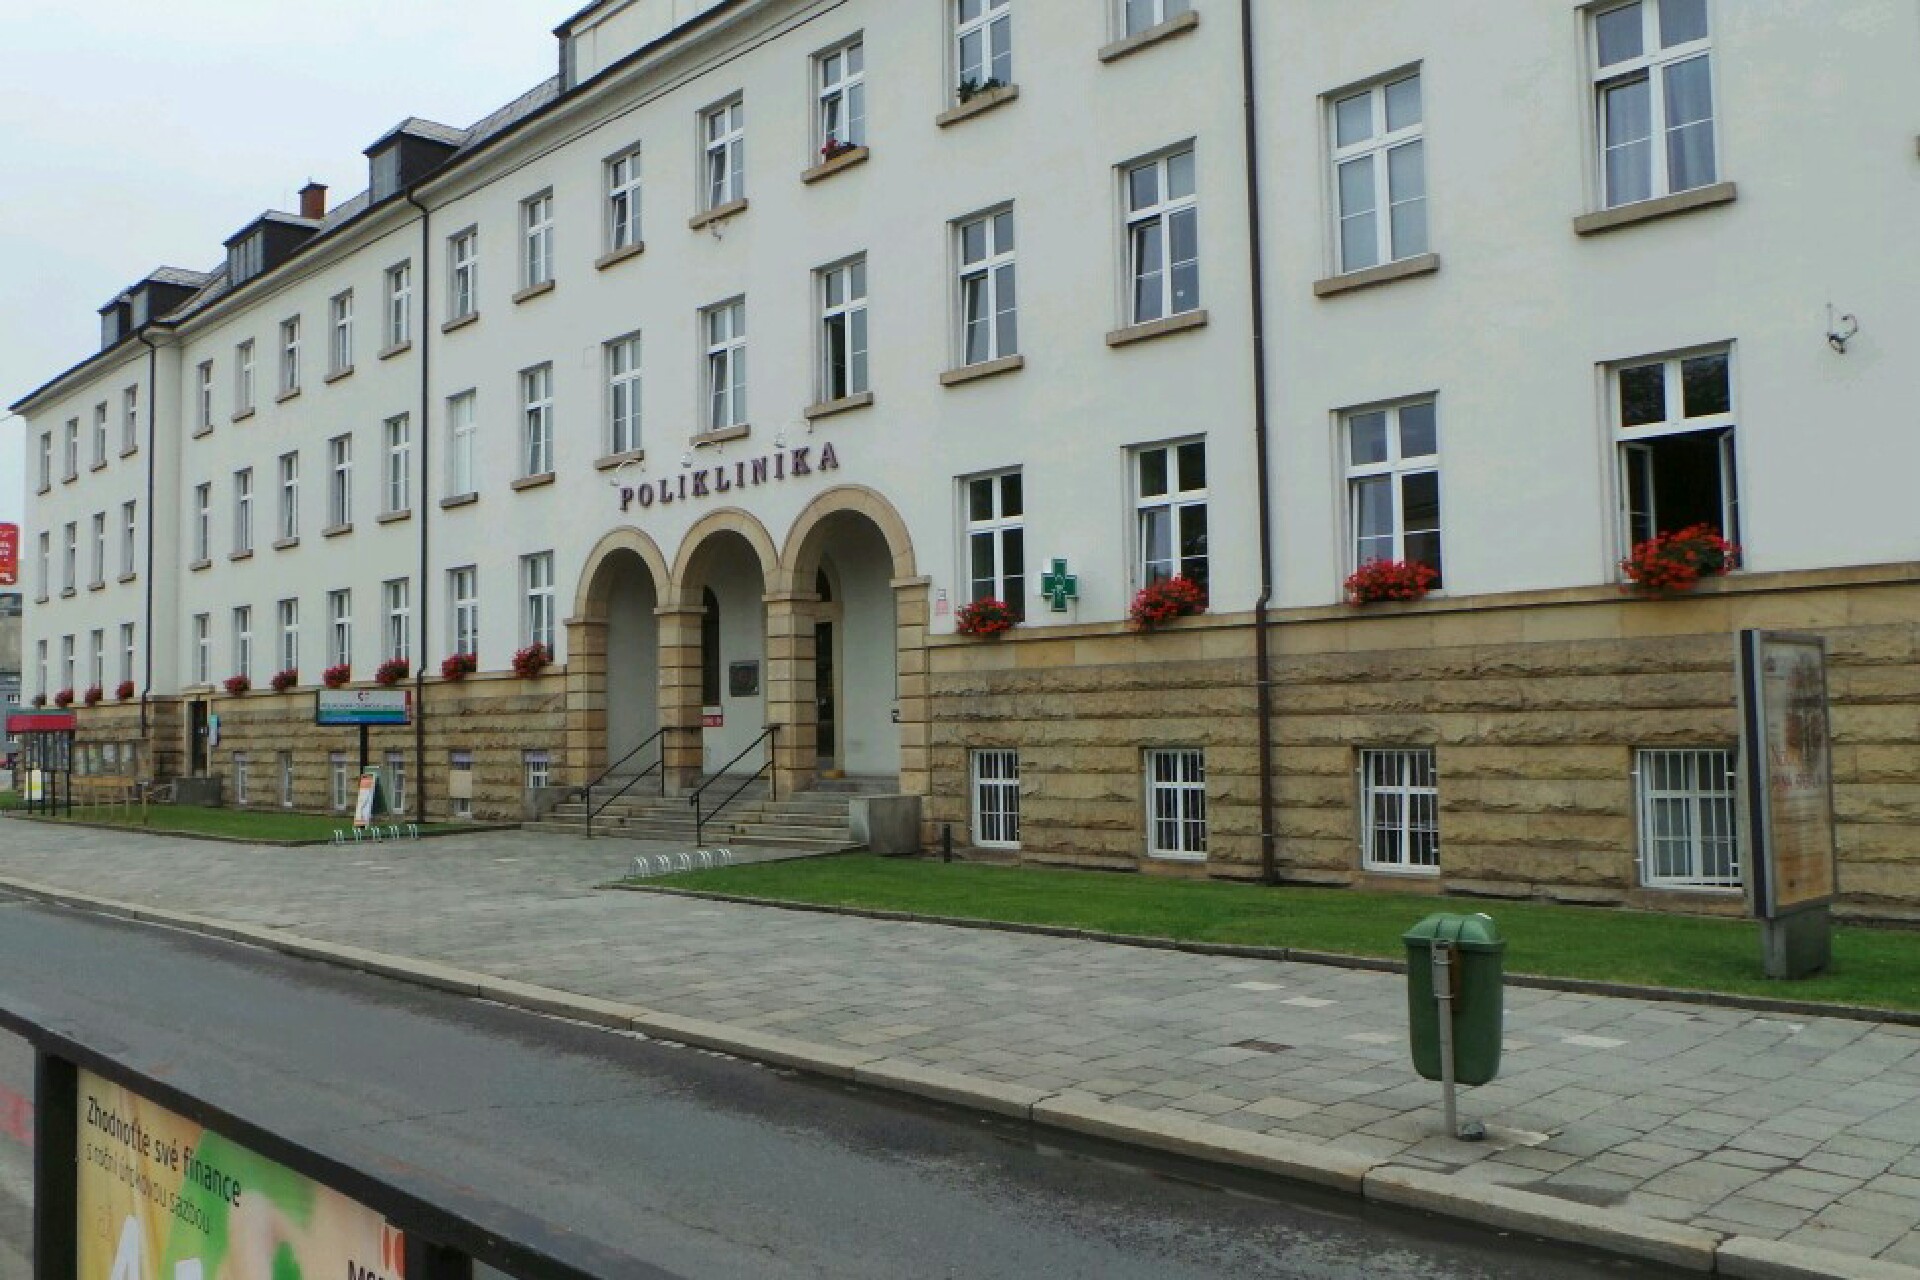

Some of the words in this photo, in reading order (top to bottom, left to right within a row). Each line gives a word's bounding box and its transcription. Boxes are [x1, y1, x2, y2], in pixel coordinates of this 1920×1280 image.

[619, 441, 839, 512] POLIKLINIKA
[87, 1143, 93, 1161] s
[155, 1138, 179, 1172] své
[183, 1145, 242, 1208] finance
